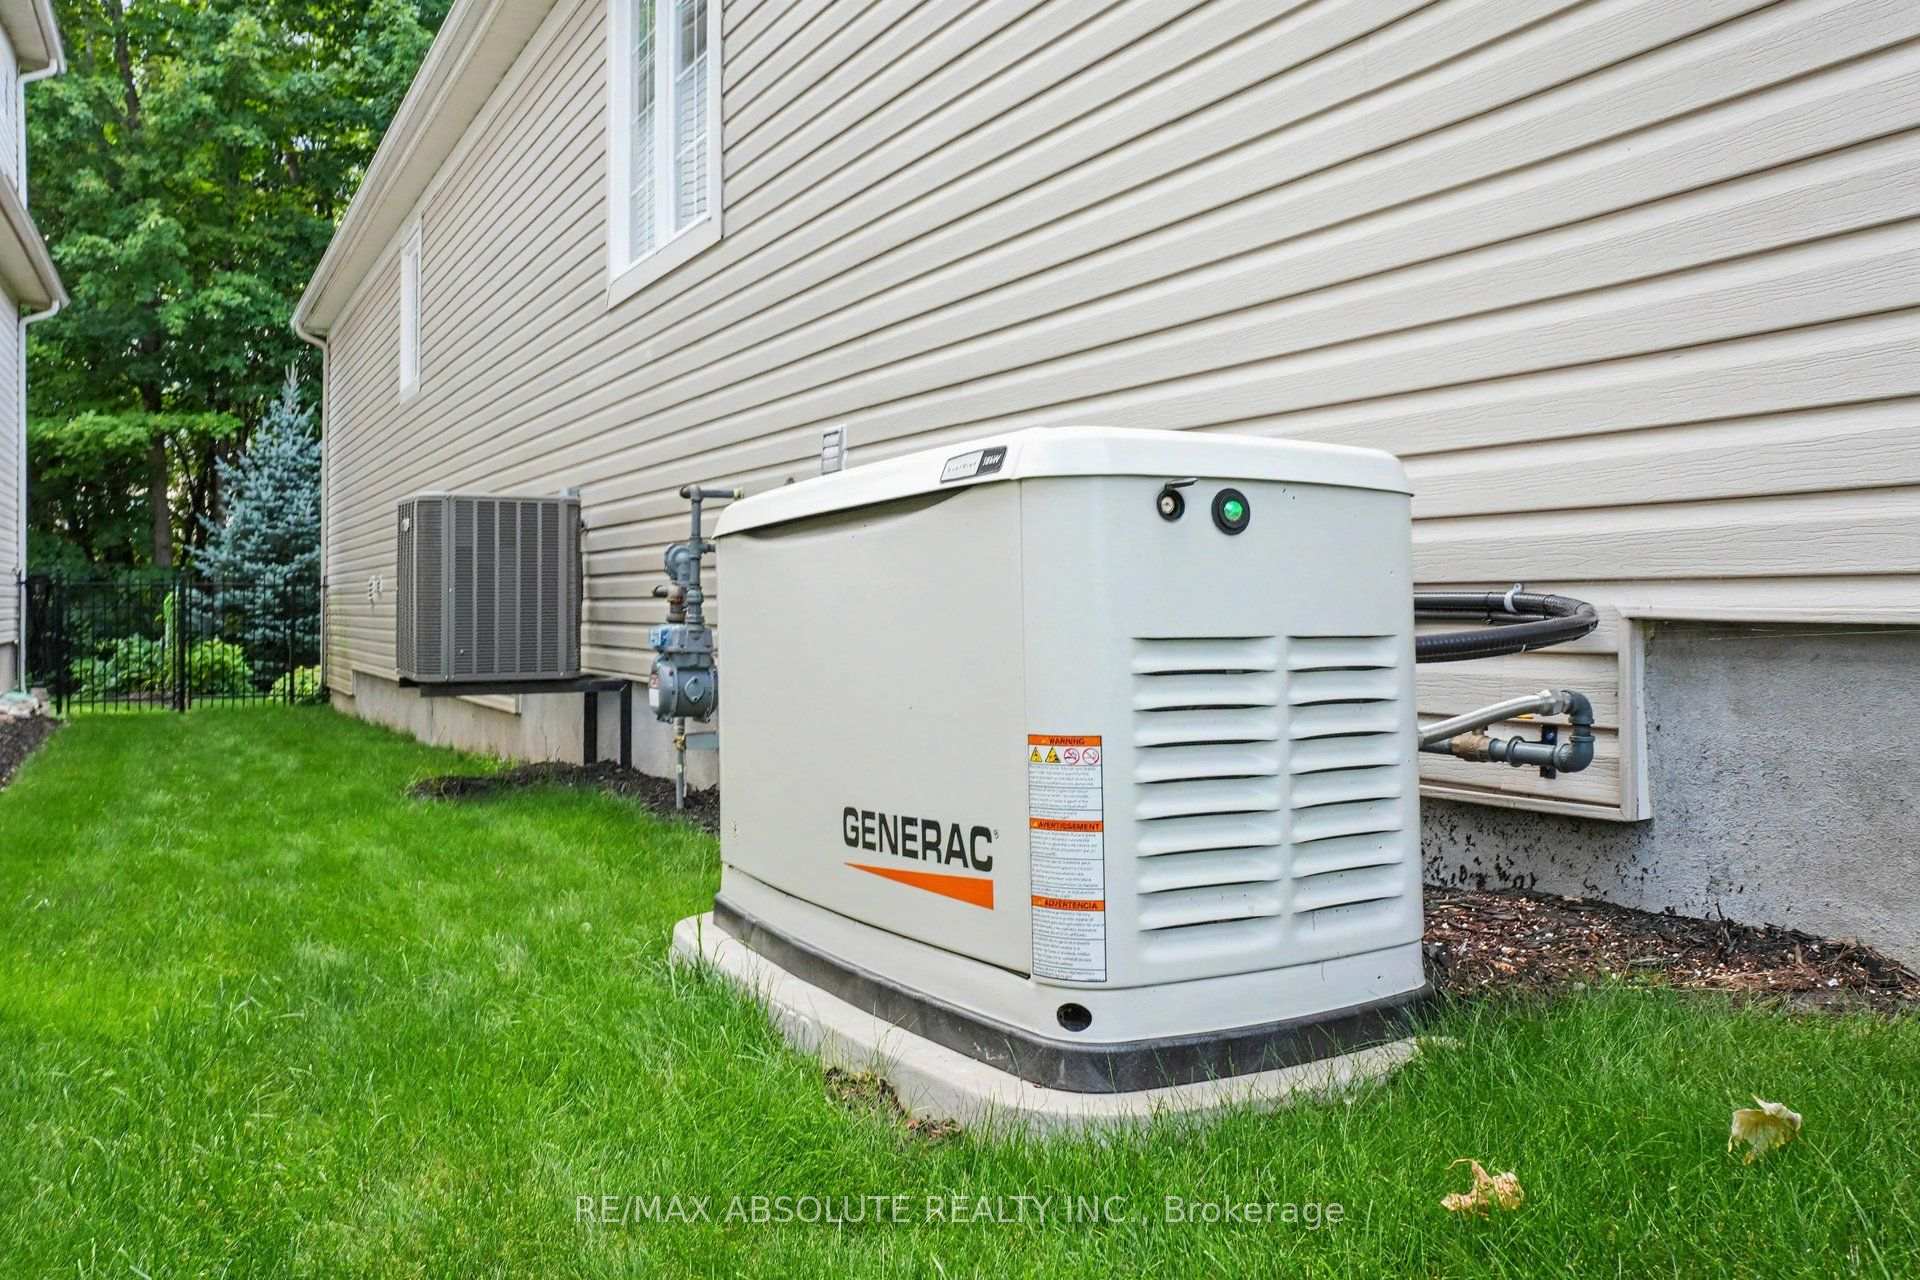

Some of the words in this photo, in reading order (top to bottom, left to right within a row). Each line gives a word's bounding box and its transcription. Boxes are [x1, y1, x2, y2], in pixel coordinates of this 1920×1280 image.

[1049, 736, 1085, 746] WARNING
[843, 806, 993, 873] GENERAC
[1044, 899, 1098, 911] ADVERTENCIA
